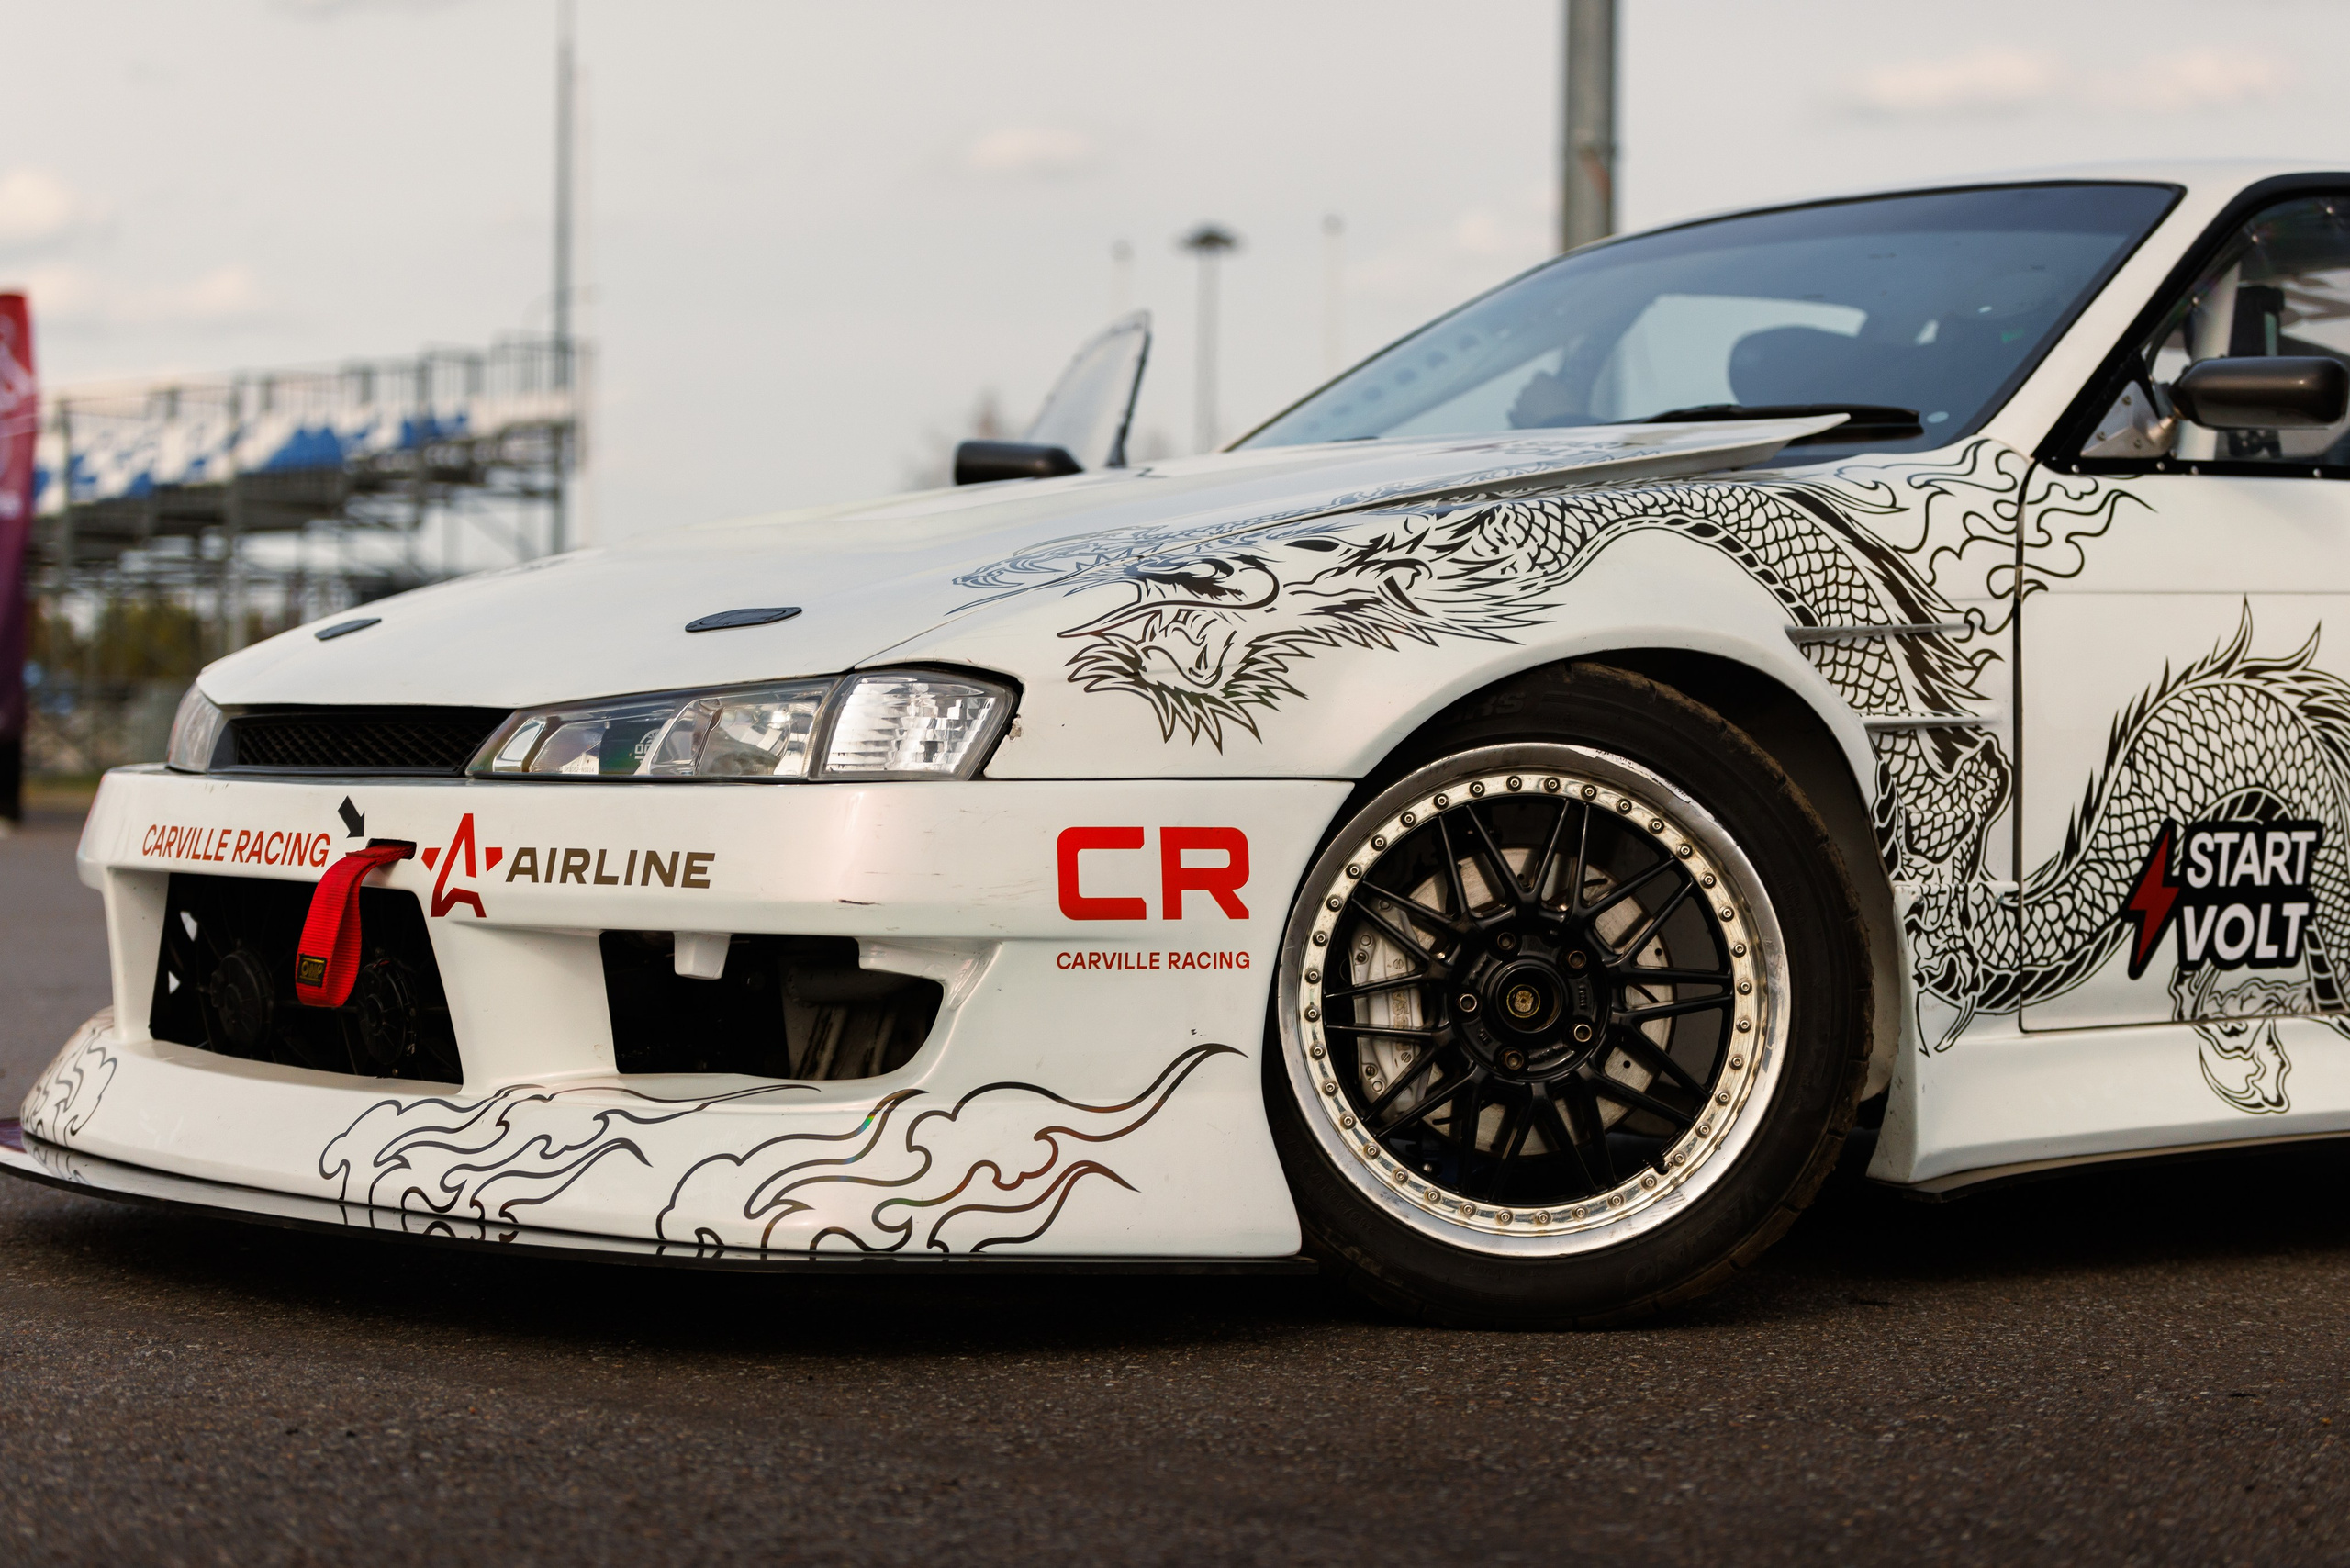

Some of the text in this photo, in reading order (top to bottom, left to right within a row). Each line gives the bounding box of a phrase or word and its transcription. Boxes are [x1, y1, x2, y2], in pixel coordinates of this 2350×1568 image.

[142, 824, 330, 868] CARVILLE RACING
[506, 846, 716, 889] AIRLINE
[2187, 831, 2317, 888] START
[1057, 826, 1249, 921] CR
[2183, 902, 2310, 961] VOLT
[300, 960, 323, 979] OMP
[1057, 951, 1250, 970] CARVILLE RACING
